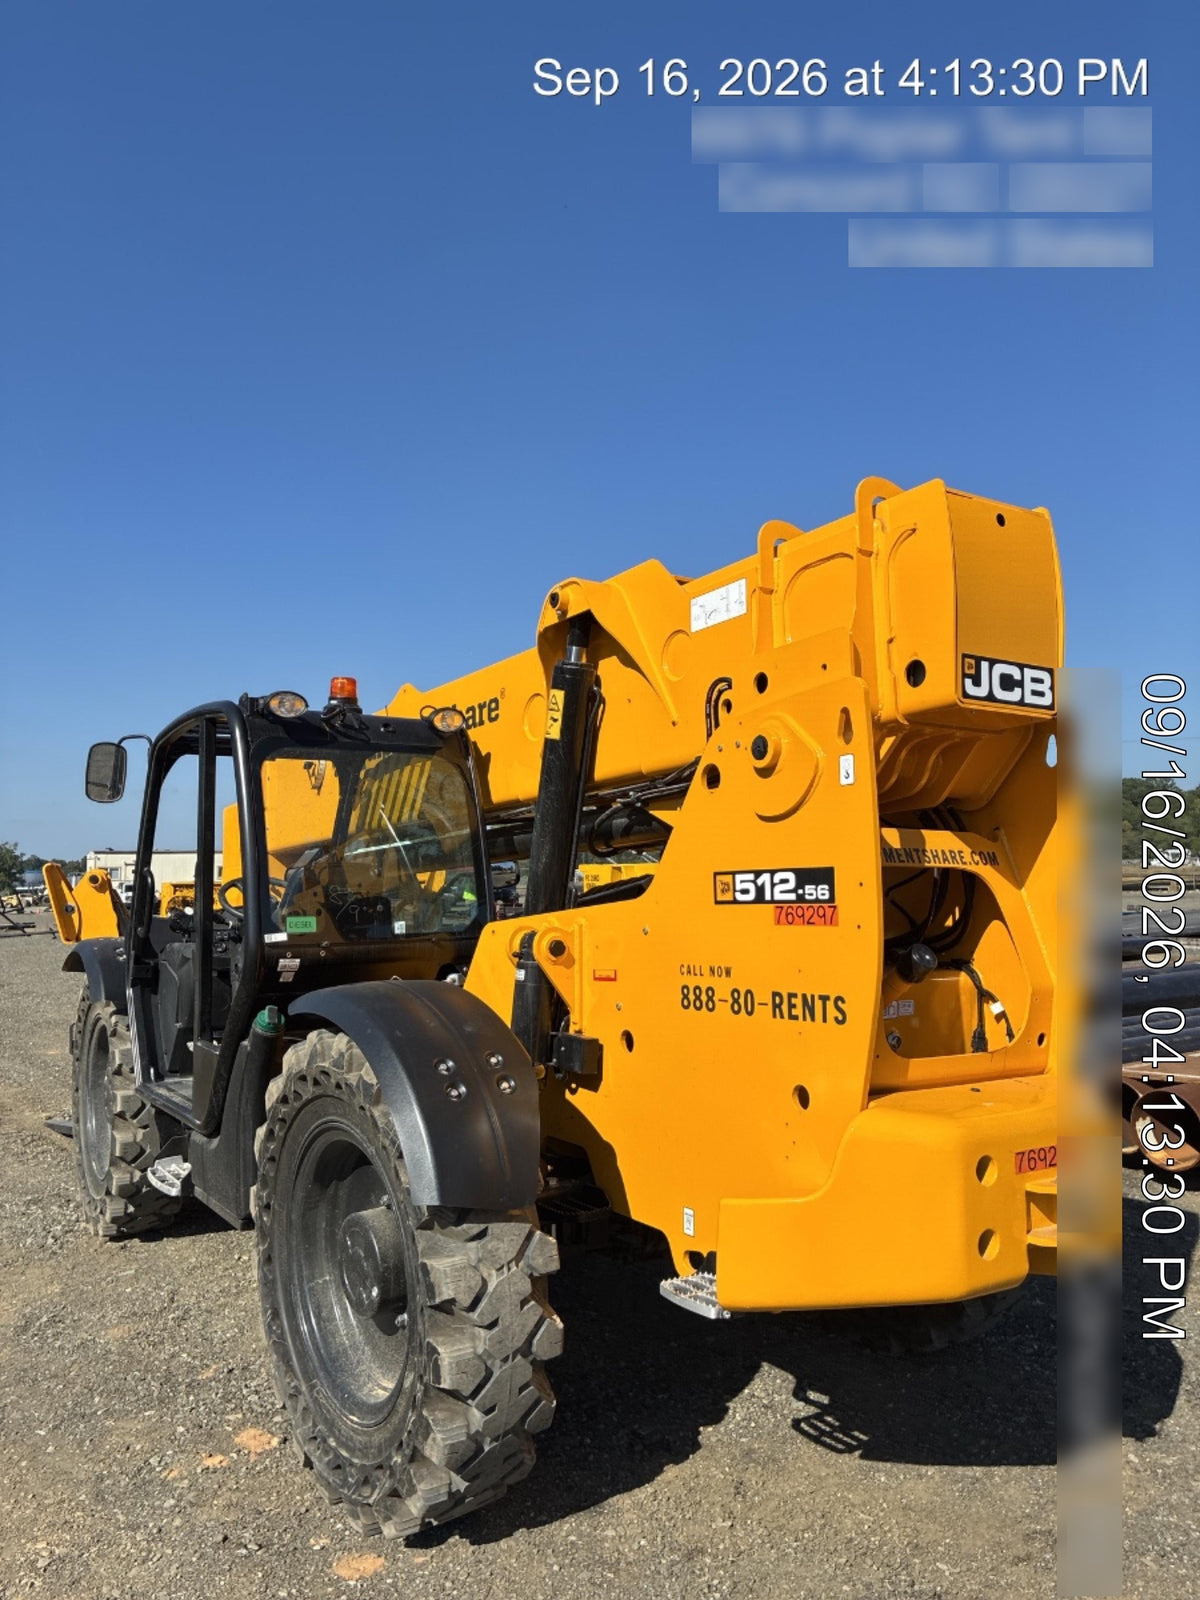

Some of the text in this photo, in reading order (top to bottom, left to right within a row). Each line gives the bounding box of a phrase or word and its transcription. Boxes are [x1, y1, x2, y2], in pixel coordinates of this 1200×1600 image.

[964, 660, 1053, 706] JCB
[775, 904, 837, 925] 769297
[679, 963, 733, 978] CALL NOW
[680, 984, 848, 1026] 888-80-RENTS
